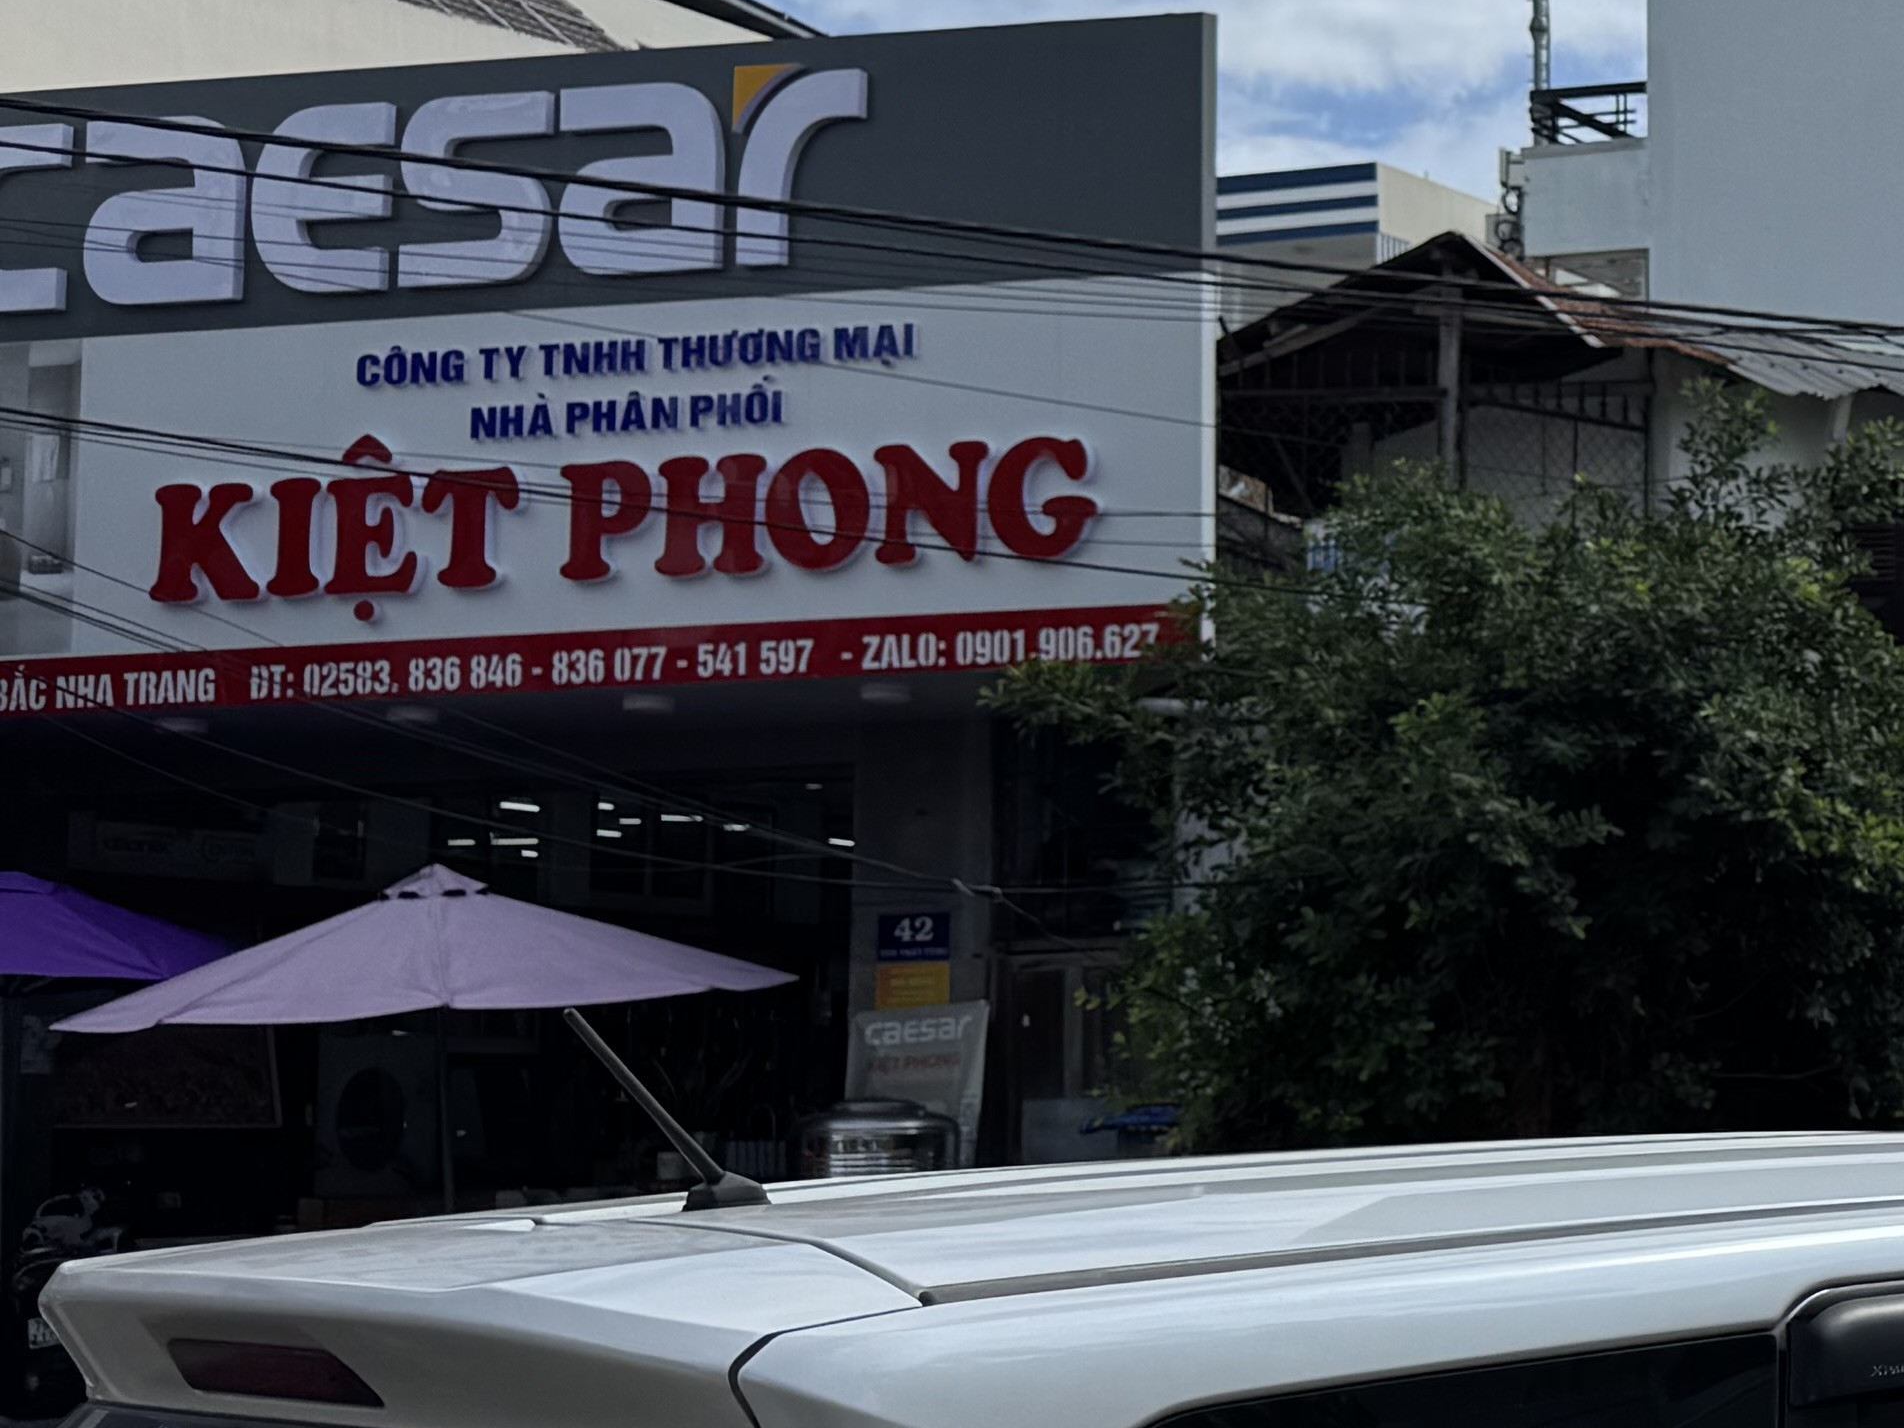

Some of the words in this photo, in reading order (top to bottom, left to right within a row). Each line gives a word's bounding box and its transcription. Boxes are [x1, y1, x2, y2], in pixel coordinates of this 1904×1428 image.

[356, 343, 467, 387] CÔNG
[478, 344, 528, 381] TY
[541, 335, 647, 377] TNHH
[656, 326, 823, 373] THƯƠNG
[830, 320, 918, 370] MẠI
[469, 390, 556, 440] NHÀ
[566, 384, 681, 434] PHÂN
[690, 373, 786, 429] PHỐI
[148, 434, 521, 623] KIỆT
[559, 435, 1100, 582] PHONG
[56, 673, 114, 710] NHA
[123, 667, 216, 706] TRANG
[303, 661, 399, 699] 02583.
[408, 655, 461, 694] 836
[470, 652, 522, 691] 846
[552, 647, 605, 686] 836
[614, 645, 667, 683] 077
[697, 641, 748, 680] 541
[759, 638, 815, 677] 597
[861, 632, 947, 672] ZALO:
[955, 621, 1160, 667] 0901.906.627
[893, 915, 935, 942] 42
[864, 1014, 974, 1047] caesar
